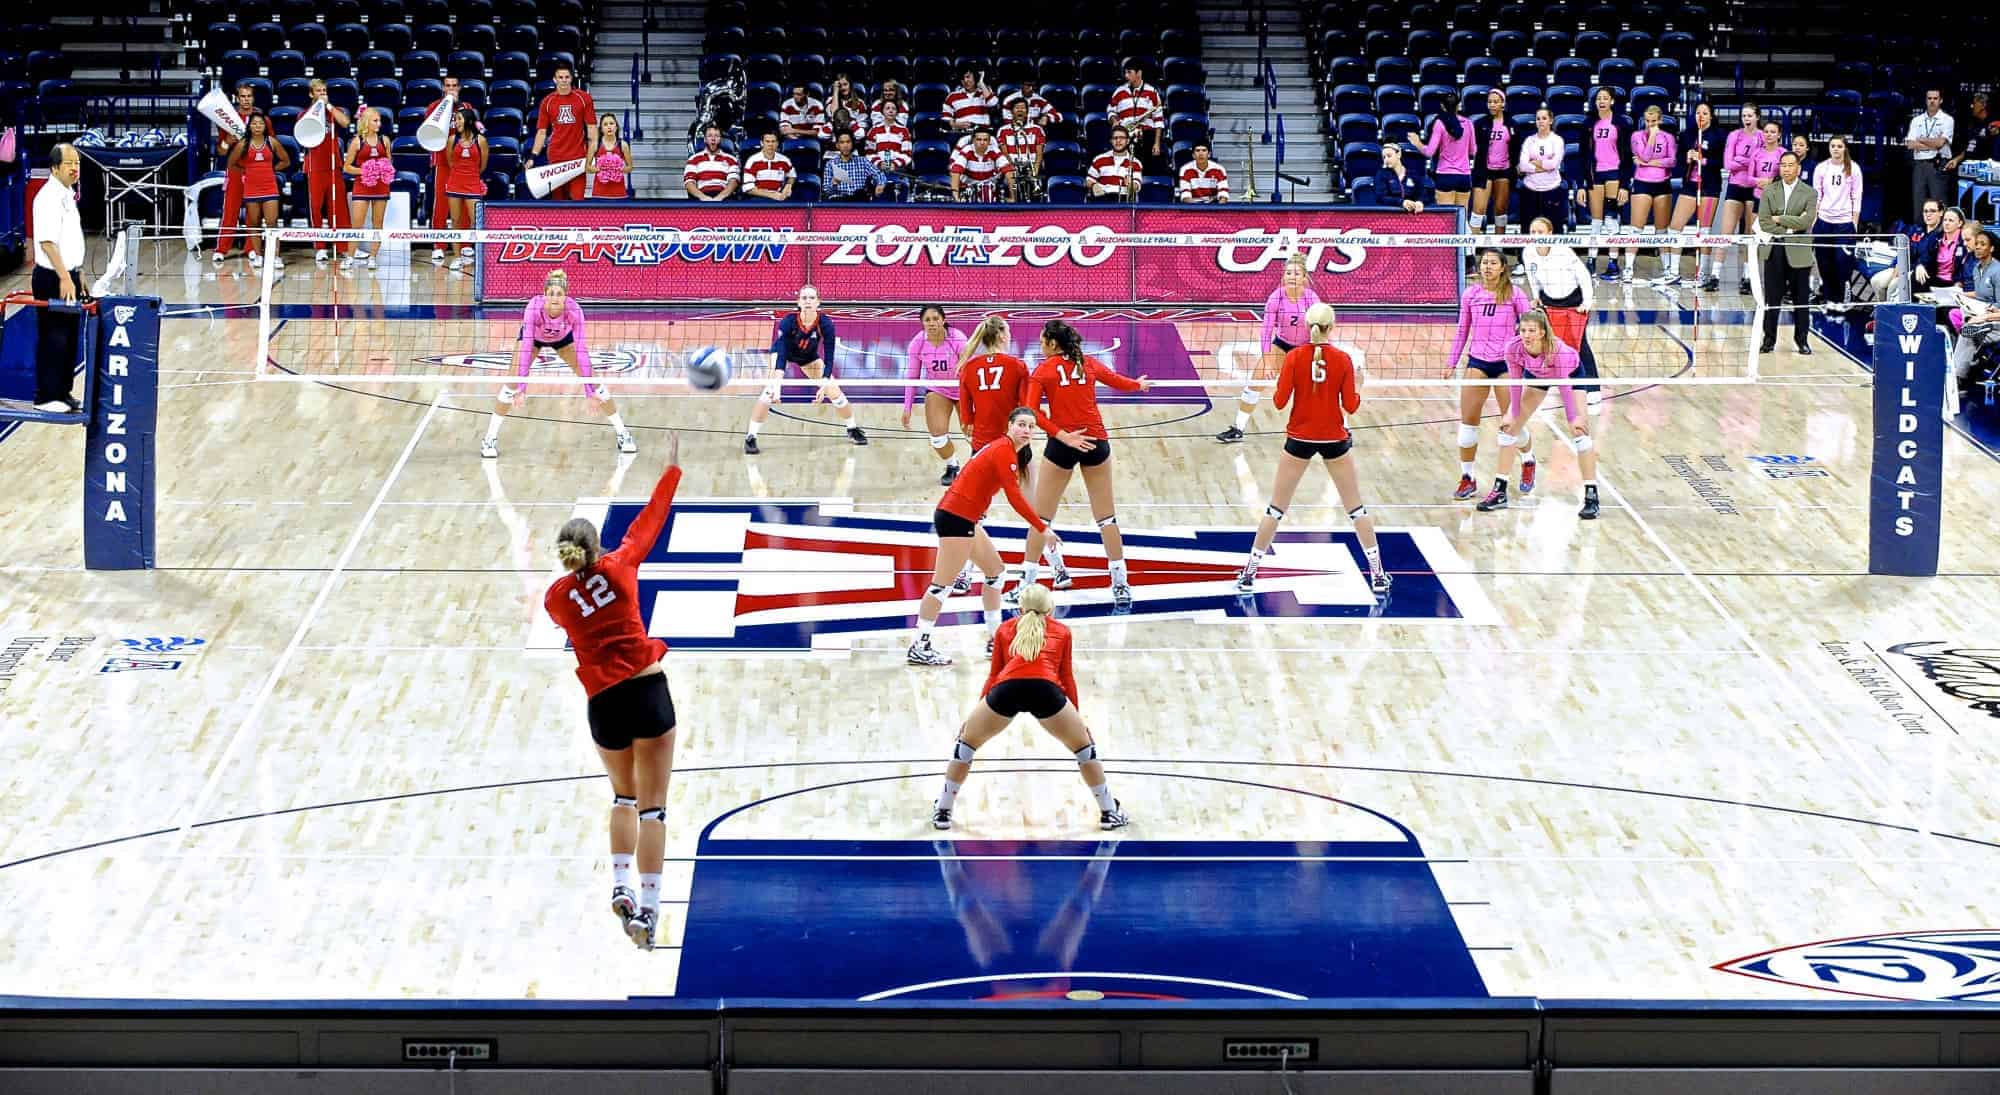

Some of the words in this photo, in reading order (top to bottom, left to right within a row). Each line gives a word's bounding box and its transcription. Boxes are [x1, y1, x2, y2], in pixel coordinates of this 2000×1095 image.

[1831, 175, 1842, 186] 13
[1217, 227, 1372, 273] CATS
[1289, 315, 1298, 327] 2
[1481, 303, 1496, 317] 10
[931, 359, 948, 373] 20
[1056, 363, 1086, 386] 14
[1310, 359, 1327, 383] 6
[976, 366, 1004, 391] 17
[104, 325, 131, 522] ARIZONA
[1895, 335, 1923, 536] WILDCATS
[568, 574, 617, 618] 12
